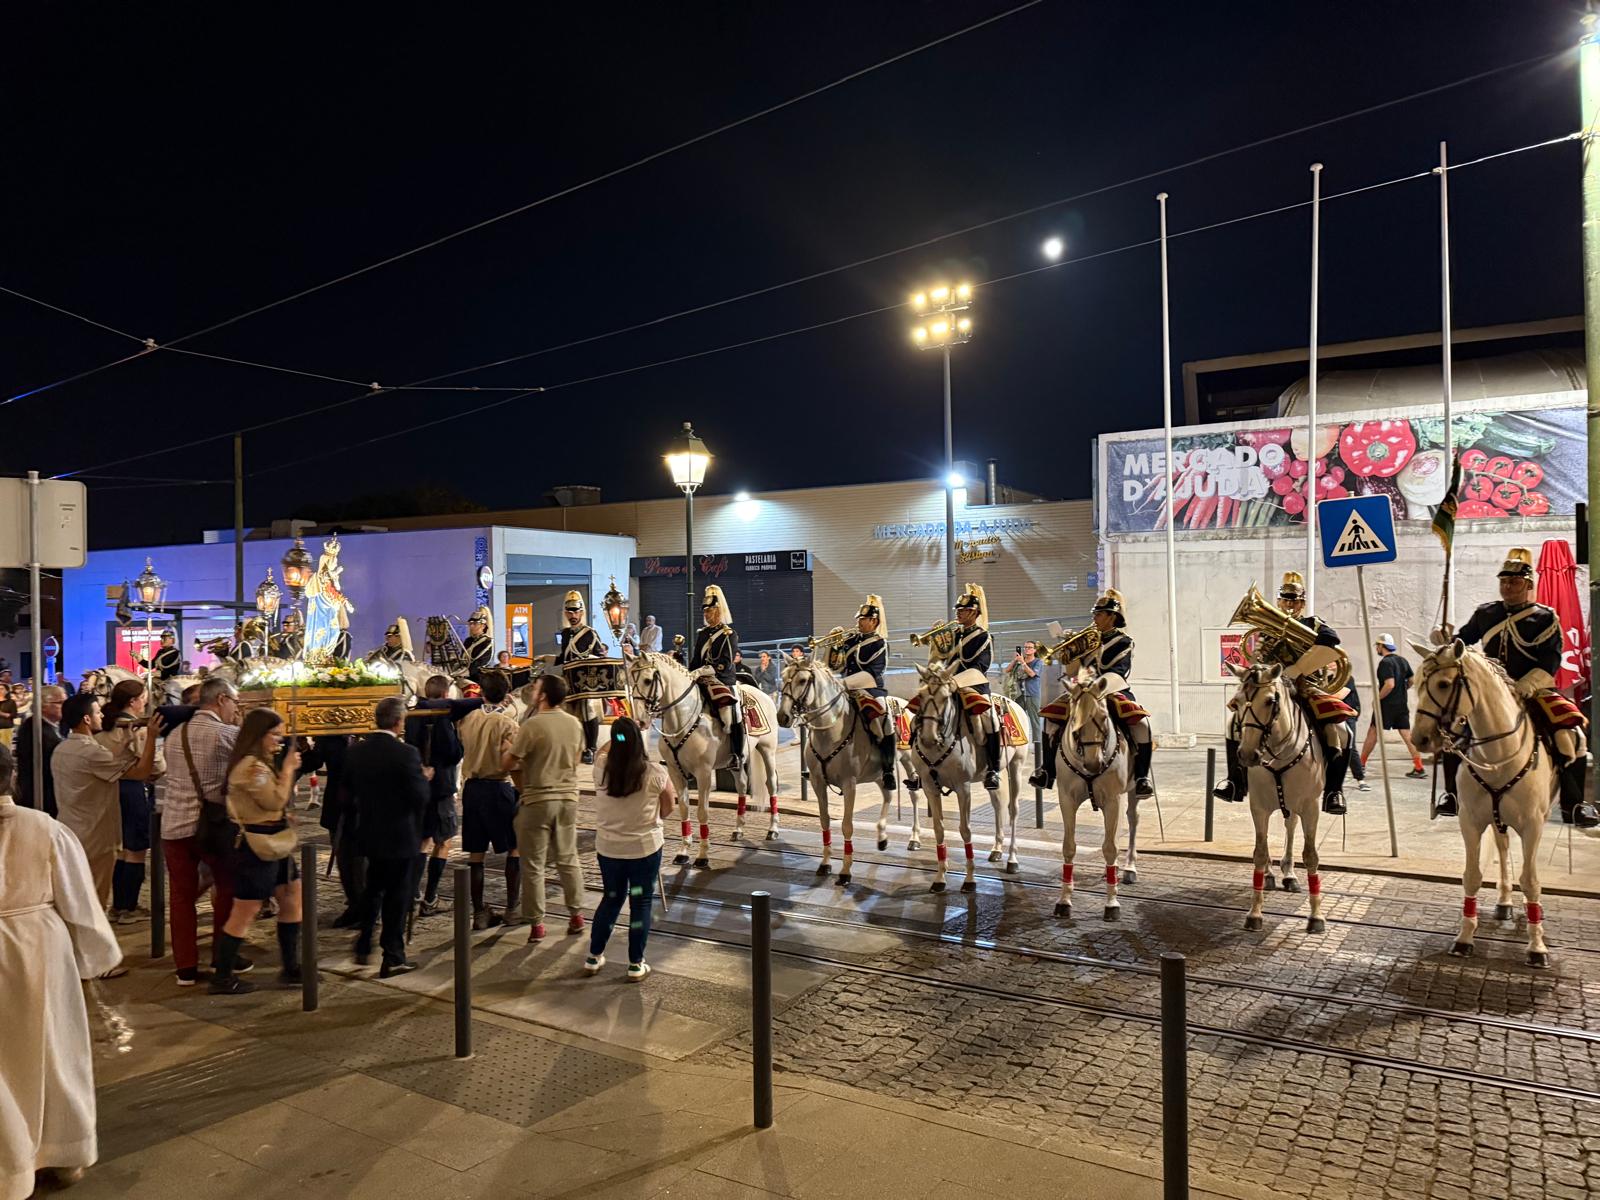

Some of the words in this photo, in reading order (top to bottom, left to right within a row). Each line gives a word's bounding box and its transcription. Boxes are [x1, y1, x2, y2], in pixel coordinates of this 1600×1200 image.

[1123, 443, 1285, 476] MERCADO
[873, 521, 947, 540] MERCADO
[745, 554, 777, 564] PASTELARIA
